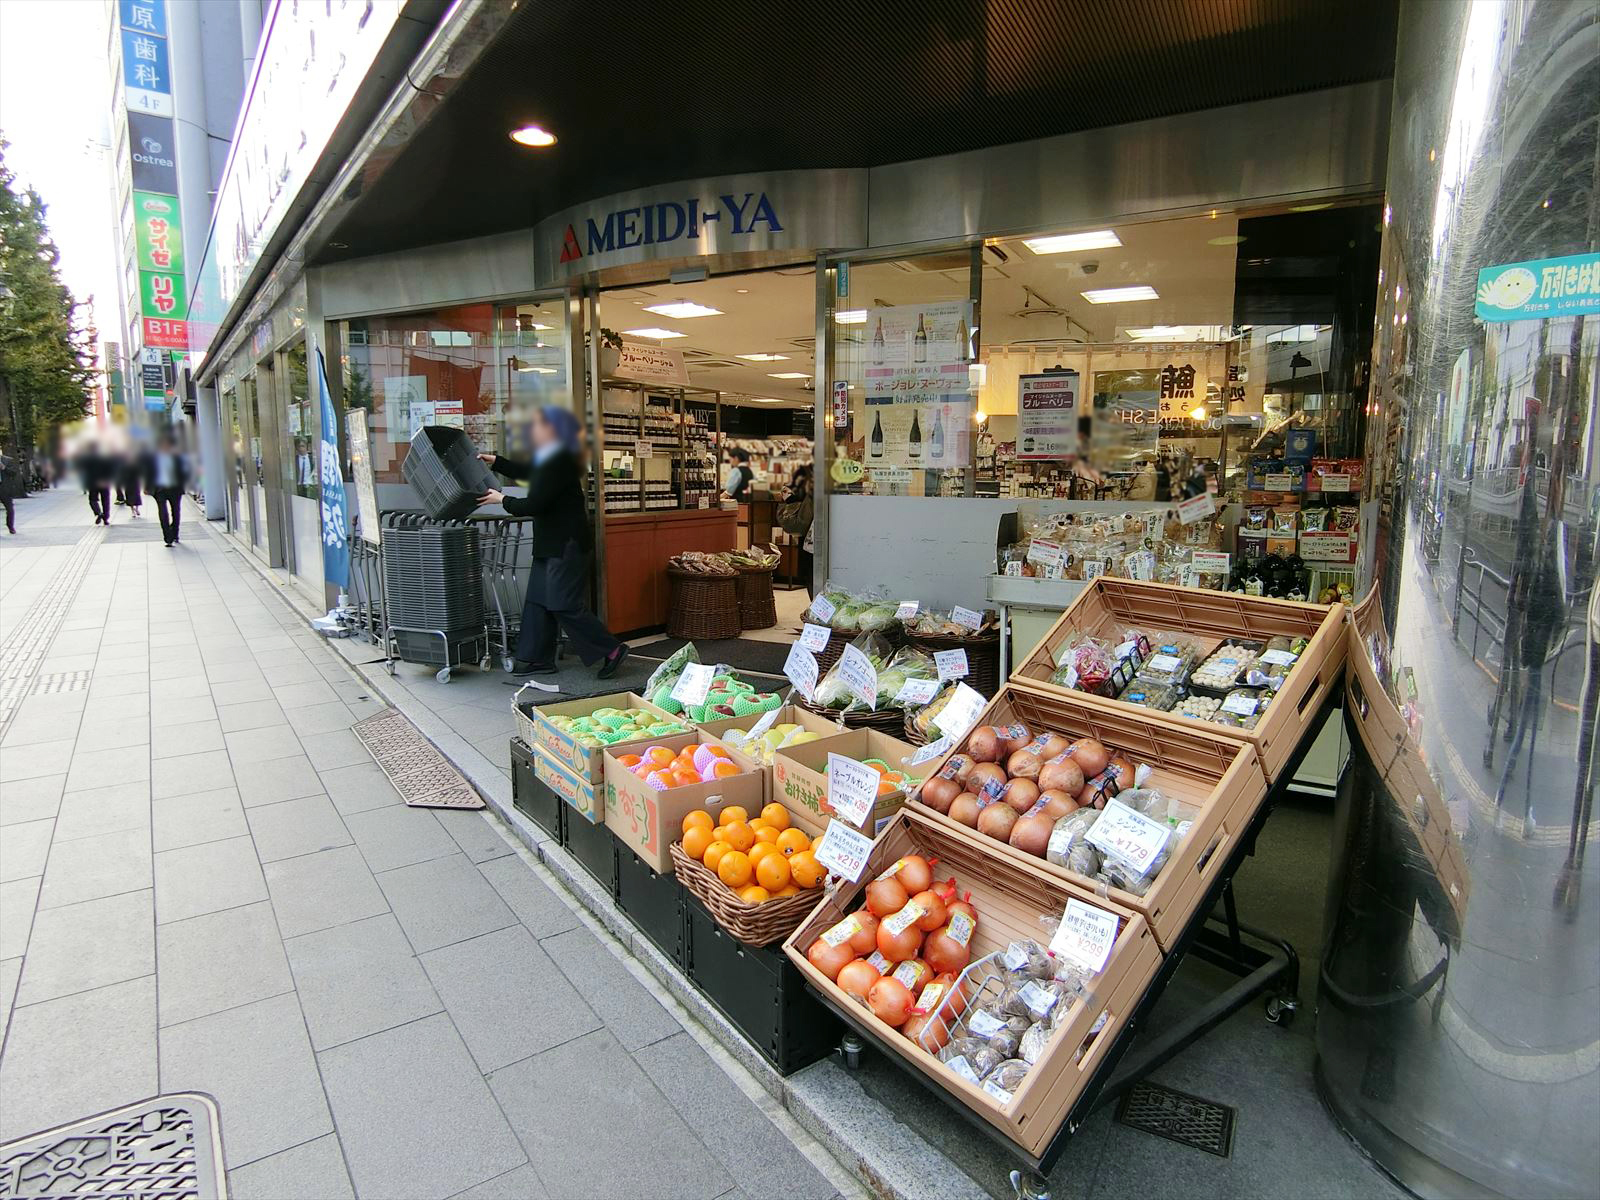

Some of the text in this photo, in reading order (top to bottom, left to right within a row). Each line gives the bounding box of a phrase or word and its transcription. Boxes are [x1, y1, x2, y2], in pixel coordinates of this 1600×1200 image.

[133, 153, 174, 168] Ostrea
[586, 191, 784, 256] MEIDI-YA
[149, 217, 175, 313] サイゼリヤ
[149, 320, 183, 335] B1F
[1024, 399, 1073, 408] ブルーベリー
[834, 769, 874, 794] ネーブルオレンジ
[785, 778, 818, 813] おけさ柿
[1116, 817, 1147, 837] シンシア
[1116, 837, 1149, 860] ¥179
[837, 853, 860, 870] ¥219
[1078, 937, 1104, 958] ¥299
